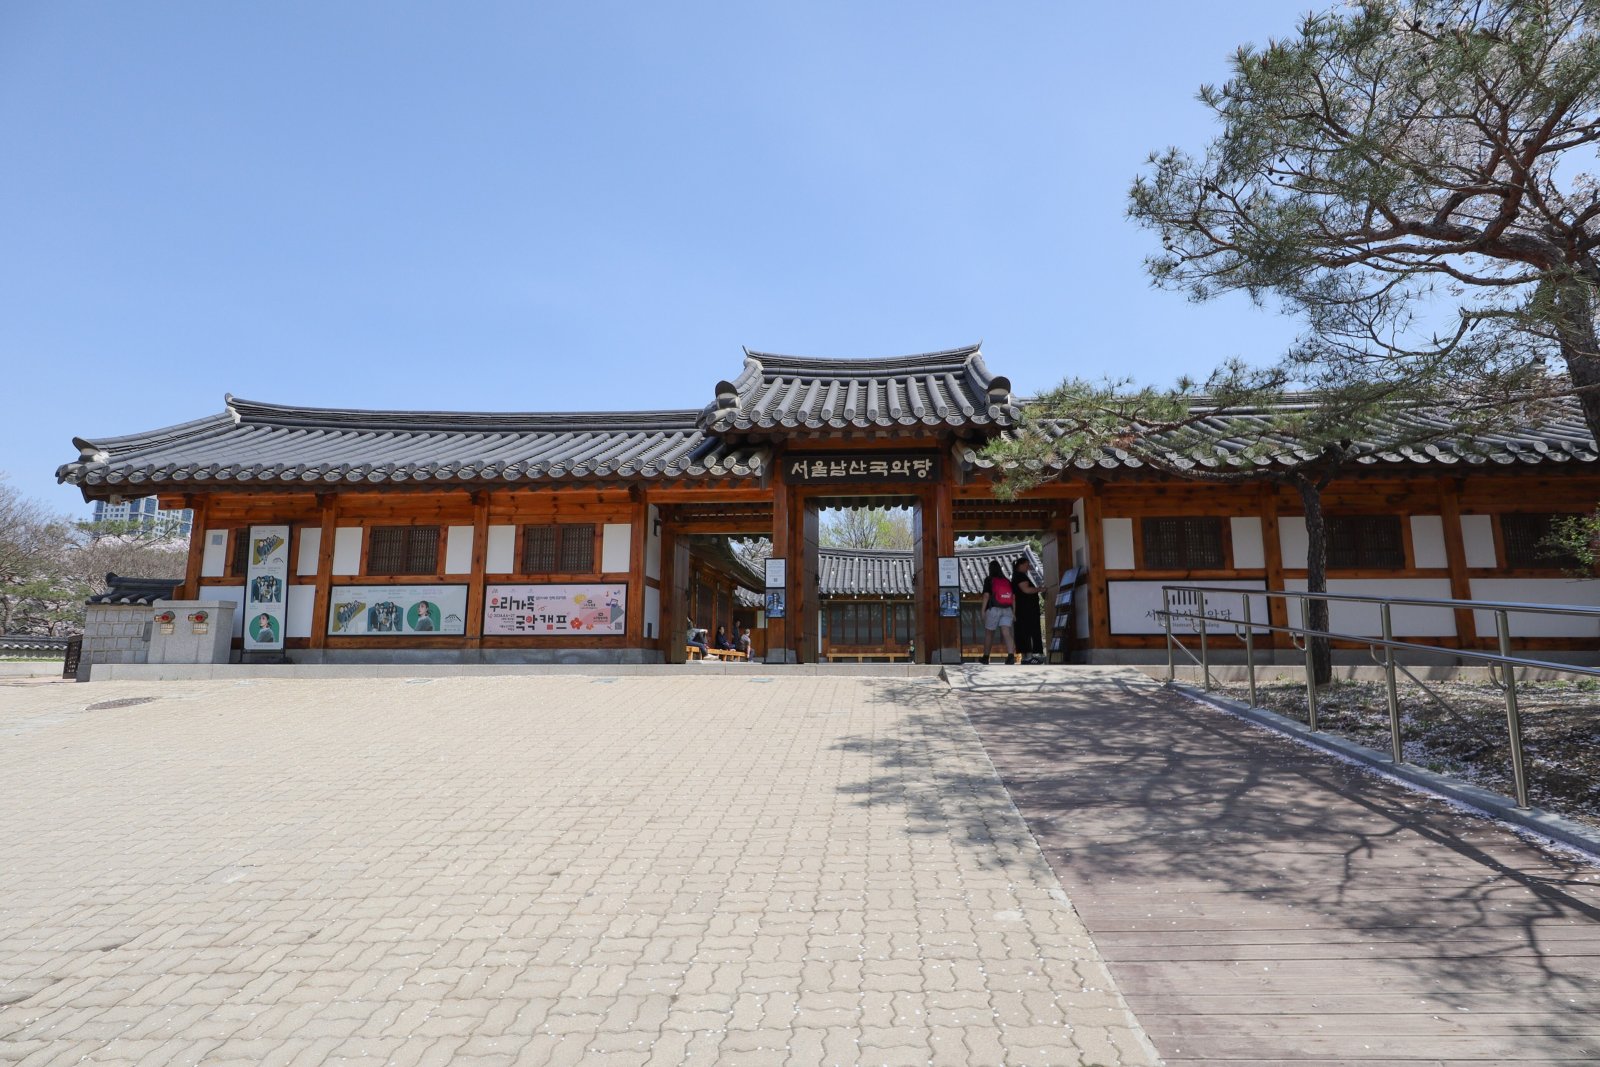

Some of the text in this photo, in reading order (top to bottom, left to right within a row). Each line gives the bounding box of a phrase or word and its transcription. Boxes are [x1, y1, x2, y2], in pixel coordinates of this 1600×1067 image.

[791, 458, 933, 479] 서울남산국악당
[489, 595, 534, 612] 우리가족
[516, 615, 567, 631] 국악캠프
